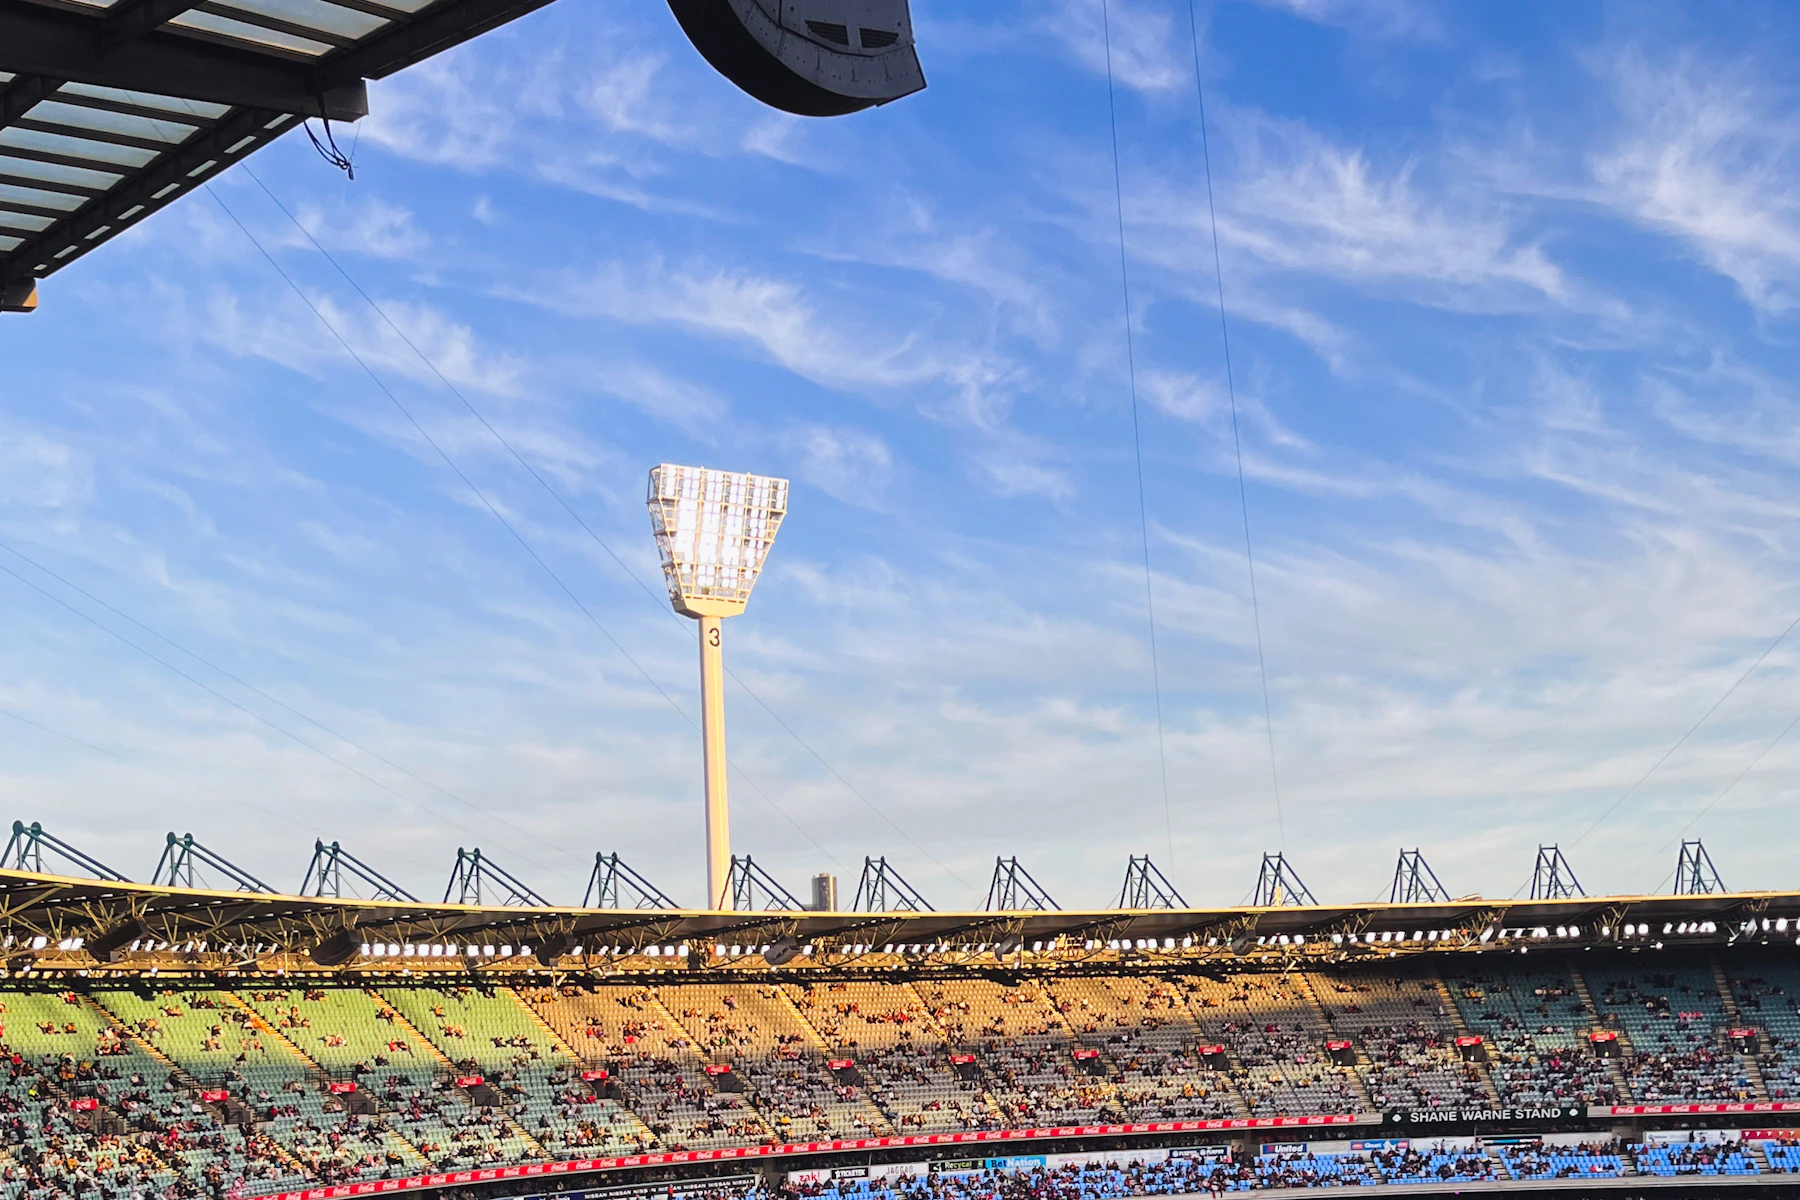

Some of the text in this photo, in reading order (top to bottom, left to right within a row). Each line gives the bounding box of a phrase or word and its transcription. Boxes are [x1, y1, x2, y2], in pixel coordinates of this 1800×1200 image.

[709, 628, 720, 647] 3
[1410, 1108, 1562, 1123] SHANE WARNE STAND
[991, 1158, 1041, 1168] BetNation
